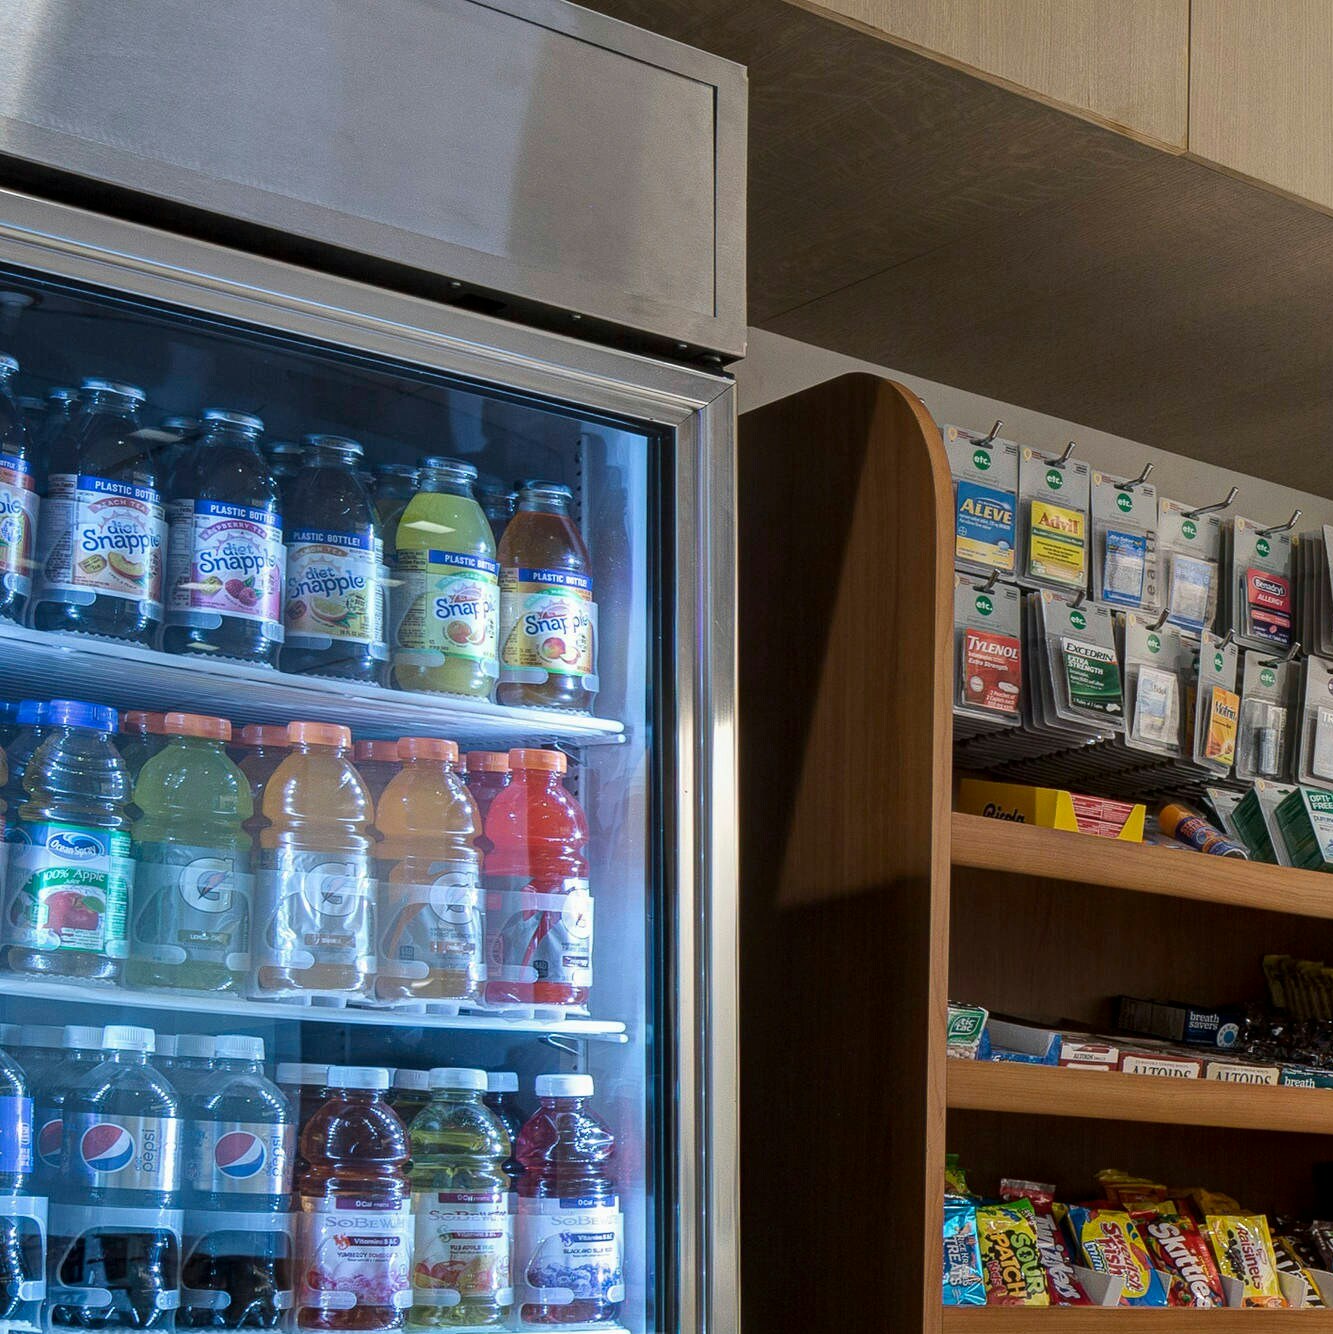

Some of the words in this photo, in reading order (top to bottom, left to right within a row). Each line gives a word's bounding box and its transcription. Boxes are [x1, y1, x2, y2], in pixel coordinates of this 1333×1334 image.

[973, 455, 992, 468] etc.
[1046, 474, 1063, 486] etc.
[95, 480, 132, 495] PLASTIC
[1117, 497, 1133, 509] etc.
[210, 504, 246, 518] PLASTIC
[959, 498, 1013, 526] ALEVE
[107, 519, 138, 536] diet
[1038, 511, 1082, 537] Advil
[327, 534, 361, 547] BOTTLE!
[222, 543, 255, 556] diet
[1255, 543, 1271, 554] etc.
[444, 554, 475, 567] PLASTIC
[306, 567, 335, 580] diet
[533, 572, 564, 583] PLASTIC
[288, 569, 366, 598] Snapple
[1254, 578, 1285, 596] Benadryl
[976, 600, 993, 613] etc.
[1069, 615, 1088, 627] etc.
[967, 635, 1019, 660] TYLENOL
[1066, 641, 1114, 662] EXCEDRIN
[1259, 673, 1276, 684] etc.
[982, 802, 1026, 824] Ricola
[73, 869, 105, 884] Apple
[959, 1016, 975, 1026] tic
[1189, 1010, 1220, 1024] breath
[955, 1024, 973, 1033] tac
[1188, 1020, 1219, 1032] savers
[1284, 1076, 1316, 1090] breath
[142, 1128, 158, 1173] pepsi
[944, 1238, 961, 1286] TREATS
[1010, 1232, 1045, 1294] SOUR
[1094, 1237, 1128, 1277] Fish
[1101, 1221, 1144, 1292] Swedish
[1237, 1225, 1263, 1291] Raisinets
[990, 1233, 1029, 1299] PATCH
